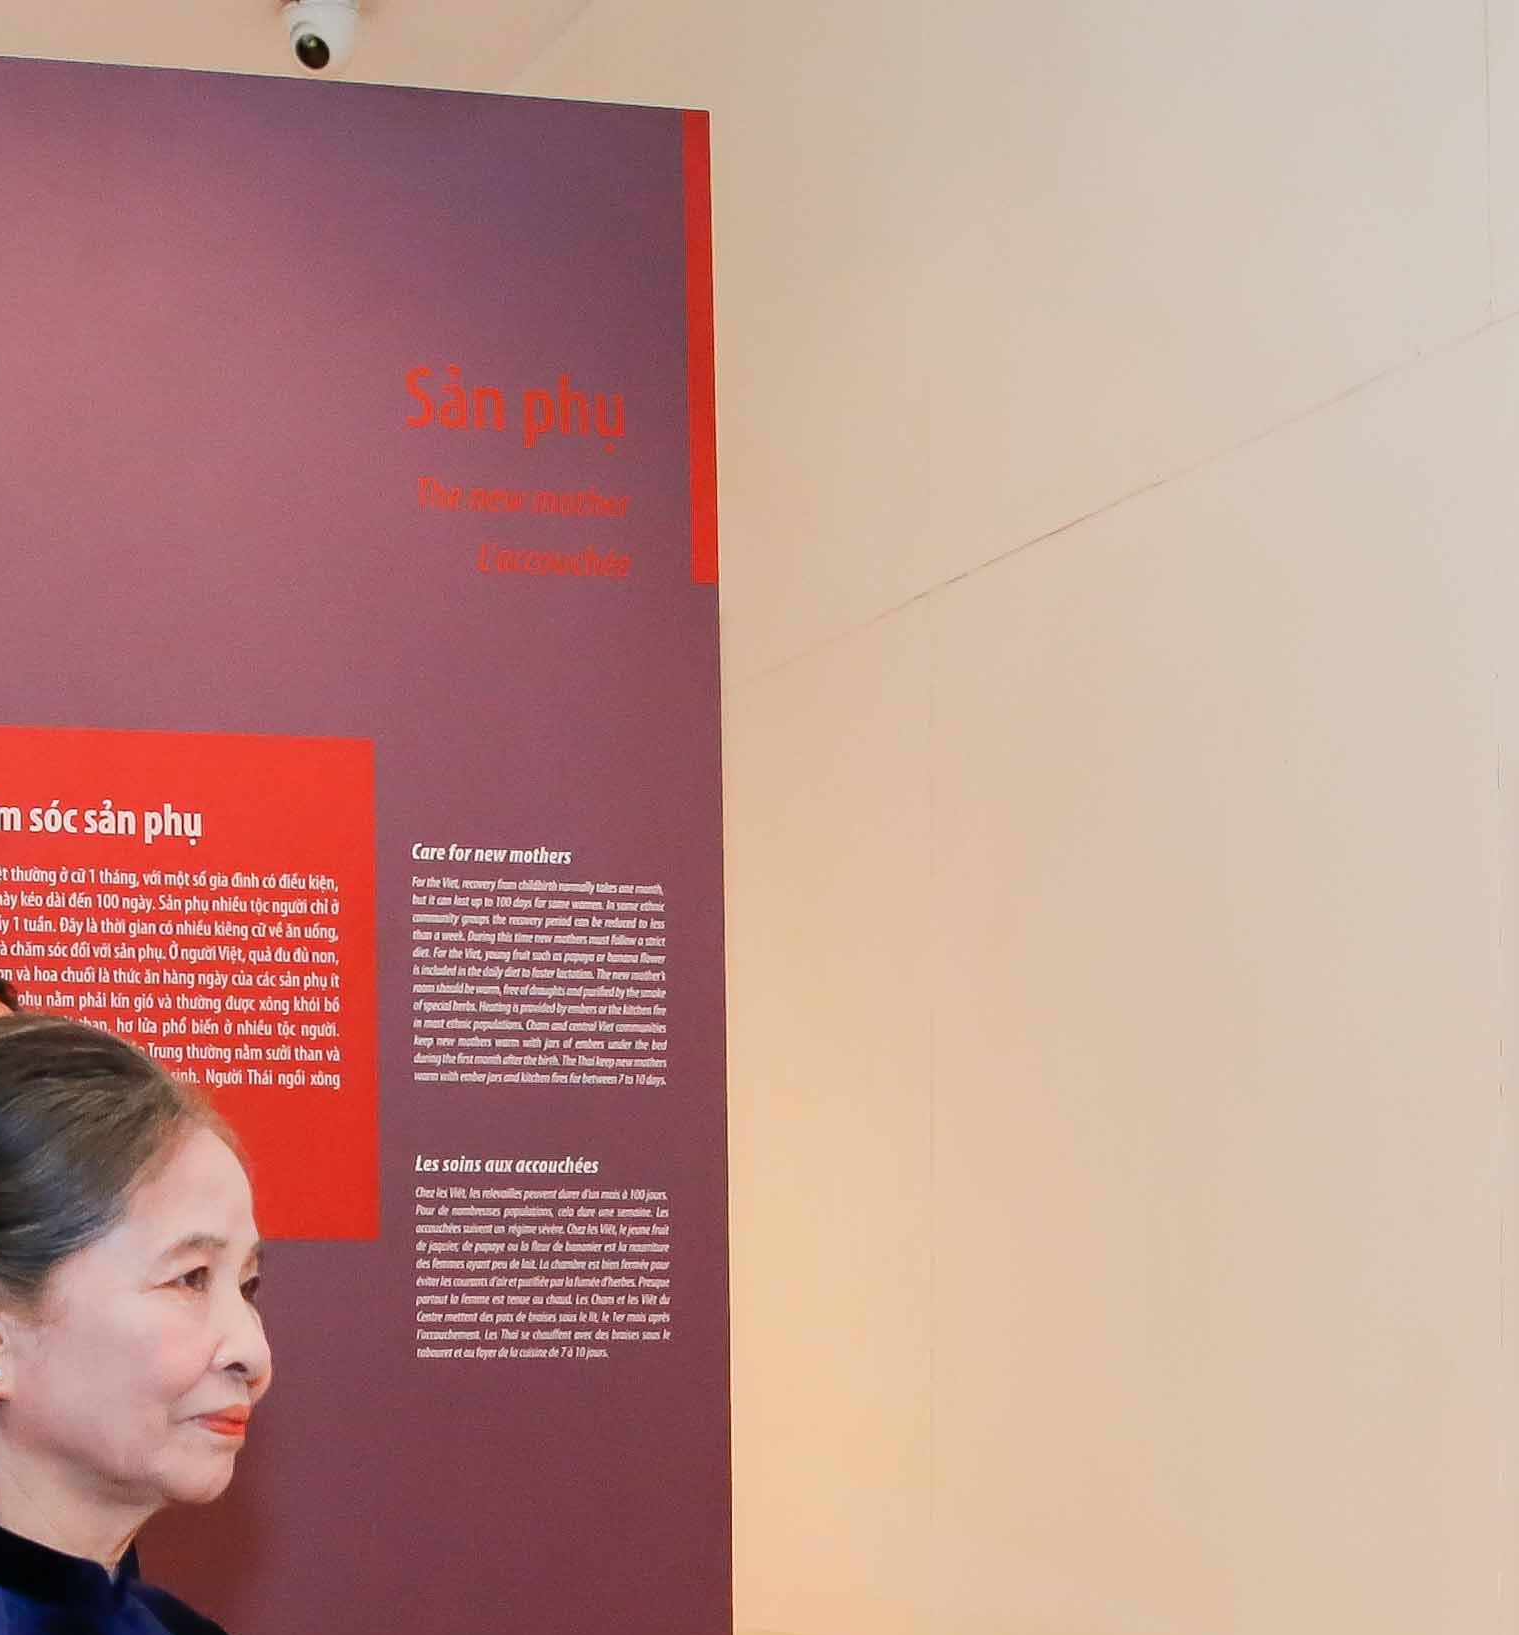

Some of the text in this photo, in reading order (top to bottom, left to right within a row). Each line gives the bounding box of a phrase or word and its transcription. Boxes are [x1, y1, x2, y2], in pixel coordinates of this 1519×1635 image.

[406, 364, 626, 454] Sản phụ
[30, 800, 77, 833] sóc
[84, 800, 135, 834] sản
[145, 804, 202, 845] phụ
[412, 843, 572, 865] Care for new mothers
[11, 866, 56, 886] thường
[60, 867, 68, 882] ở
[71, 868, 86, 883] cữ
[89, 869, 94, 883] 1
[100, 868, 139, 888] tháng,
[143, 870, 161, 885] với
[165, 871, 189, 888] một
[193, 871, 206, 886] số
[209, 873, 228, 890] gia
[231, 872, 259, 888] đình
[262, 874, 276, 888] có
[279, 873, 306, 889] điều
[309, 875, 338, 893] kiện,
[21, 891, 43, 906] kéo
[46, 892, 65, 907] dài
[69, 892, 92, 908] đến
[97, 894, 119, 908] 100
[122, 895, 155, 913] ngày.
[159, 894, 181, 910] Sản
[185, 896, 208, 914] phụ
[212, 896, 247, 912] nhiều
[251, 898, 269, 915] tộc
[272, 899, 307, 917] người
[310, 899, 328, 914] chỉ
[331, 899, 339, 914] ở
[14, 917, 18, 931] 1
[60, 917, 83, 936] Đây
[87, 918, 97, 933] là
[101, 918, 125, 933] thời
[129, 919, 156, 937] gian
[159, 920, 173, 935] có
[176, 920, 211, 936] nhiều
[215, 921, 248, 940] kiêng
[252, 923, 266, 937] cữ
[269, 922, 283, 937] về
[286, 924, 301, 937] ăn
[305, 923, 338, 942] uống,
[10, 941, 45, 956] chăm
[48, 942, 68, 957] sóc
[71, 941, 90, 957] đối
[93, 943, 111, 958] với
[114, 943, 135, 958] sản
[138, 944, 166, 962] phụ.
[169, 941, 178, 959] Ở
[181, 946, 216, 964] người
[218, 946, 245, 964] Việt,
[249, 946, 271, 965] quả
[274, 947, 290, 962] đu
[312, 952, 338, 965] non,
[17, 966, 30, 981] và
[34, 966, 57, 981] hoa
[61, 966, 95, 982] chuối
[99, 968, 109, 983] là
[113, 968, 140, 983] thức
[144, 969, 159, 984] ăn
[163, 969, 194, 988] hàng
[198, 970, 228, 989] ngày
[232, 970, 252, 985] của
[257, 972, 276, 986] các
[279, 971, 300, 986] sản
[304, 972, 327, 990] phụ
[331, 973, 339, 987] ít
[79, 992, 106, 1011] phải
[111, 992, 129, 1008] kín
[134, 994, 153, 1012] gió
[158, 994, 171, 1008] và
[177, 994, 221, 1013] thường
[225, 995, 255, 1013] được
[259, 996, 289, 1015] xông
[294, 996, 320, 1011] khói
[117, 1017, 133, 1033] hơ
[138, 1017, 157, 1033] lửa
[163, 1017, 186, 1036] phổ
[192, 1019, 218, 1034] biến
[224, 1019, 232, 1034] ở
[237, 1020, 272, 1035] nhiều
[278, 1021, 295, 1038] tộc
[301, 1022, 339, 1040] người.
[148, 1043, 182, 1062] Trung
[187, 1044, 231, 1063] thường
[266, 1045, 291, 1060] sưởi
[295, 1046, 322, 1060] than
[326, 1047, 340, 1061] và
[206, 1069, 242, 1088] Người
[247, 1069, 272, 1084] Thái
[278, 1069, 305, 1089] ngồi
[311, 1071, 340, 1089] xông
[415, 1155, 600, 1174] Les soins aux accouchées
